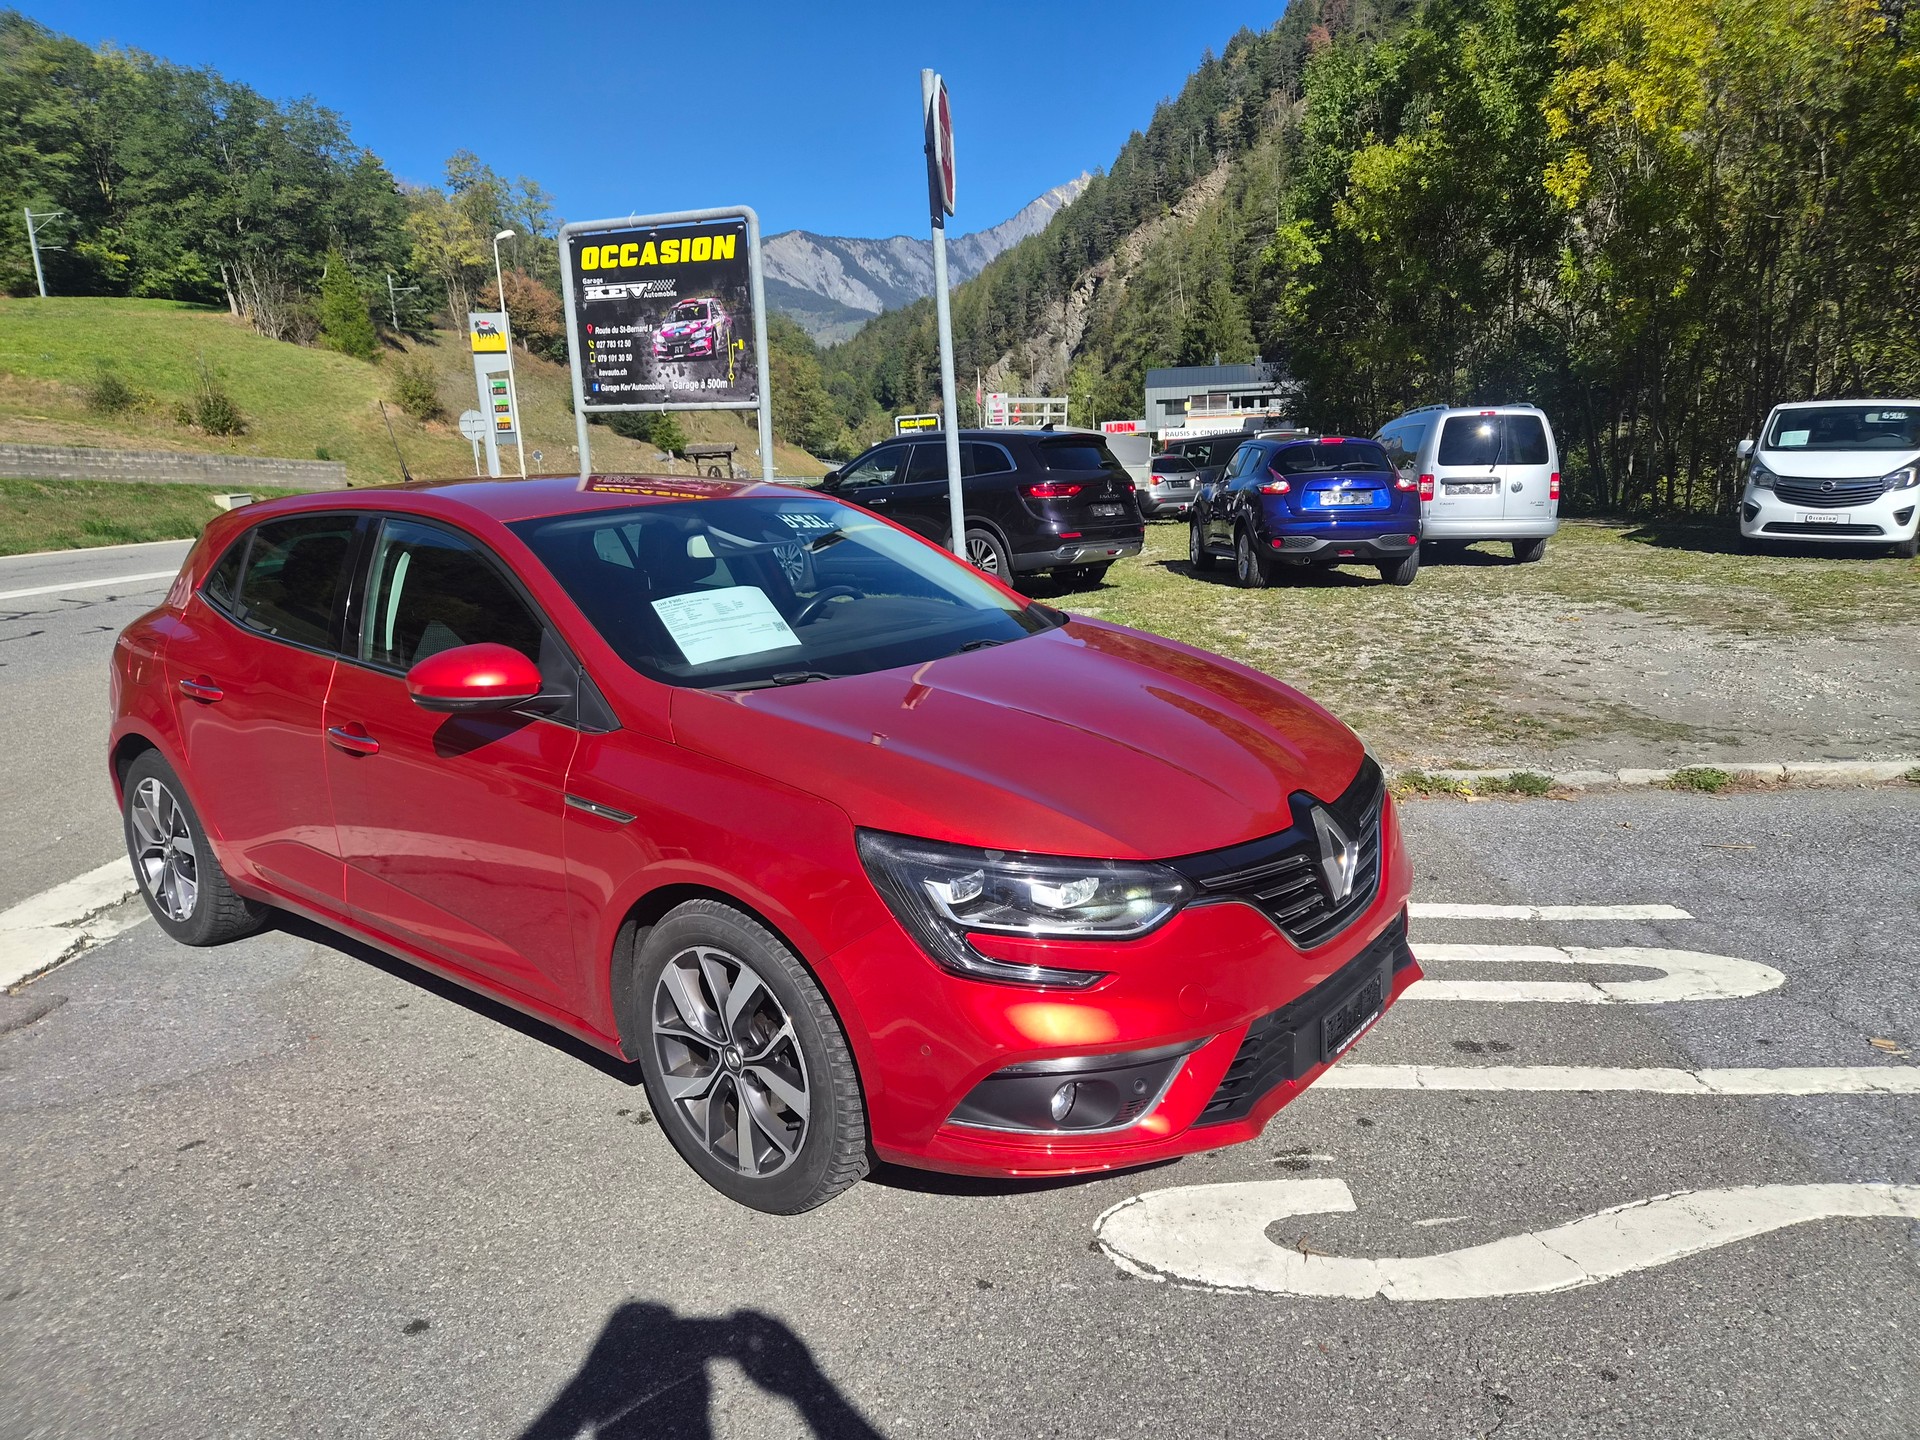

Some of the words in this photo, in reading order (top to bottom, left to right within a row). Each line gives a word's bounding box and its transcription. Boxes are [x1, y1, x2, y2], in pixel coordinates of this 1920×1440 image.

[581, 235, 737, 271] OCCASION
[643, 290, 677, 299] Automobile
[595, 326, 611, 334] Route
[612, 326, 619, 334] du
[620, 324, 648, 333] St-Bernard
[596, 340, 606, 348] 027
[607, 340, 616, 348] 783
[625, 339, 631, 347] 50
[598, 354, 607, 362] 079
[608, 354, 617, 362] 101
[618, 353, 625, 361] 30
[626, 353, 632, 361] 50
[599, 368, 628, 376] kevauto.ch
[601, 383, 620, 393] Garage
[672, 380, 699, 391] Garage
[700, 379, 706, 389] à
[707, 378, 728, 389] 500m
